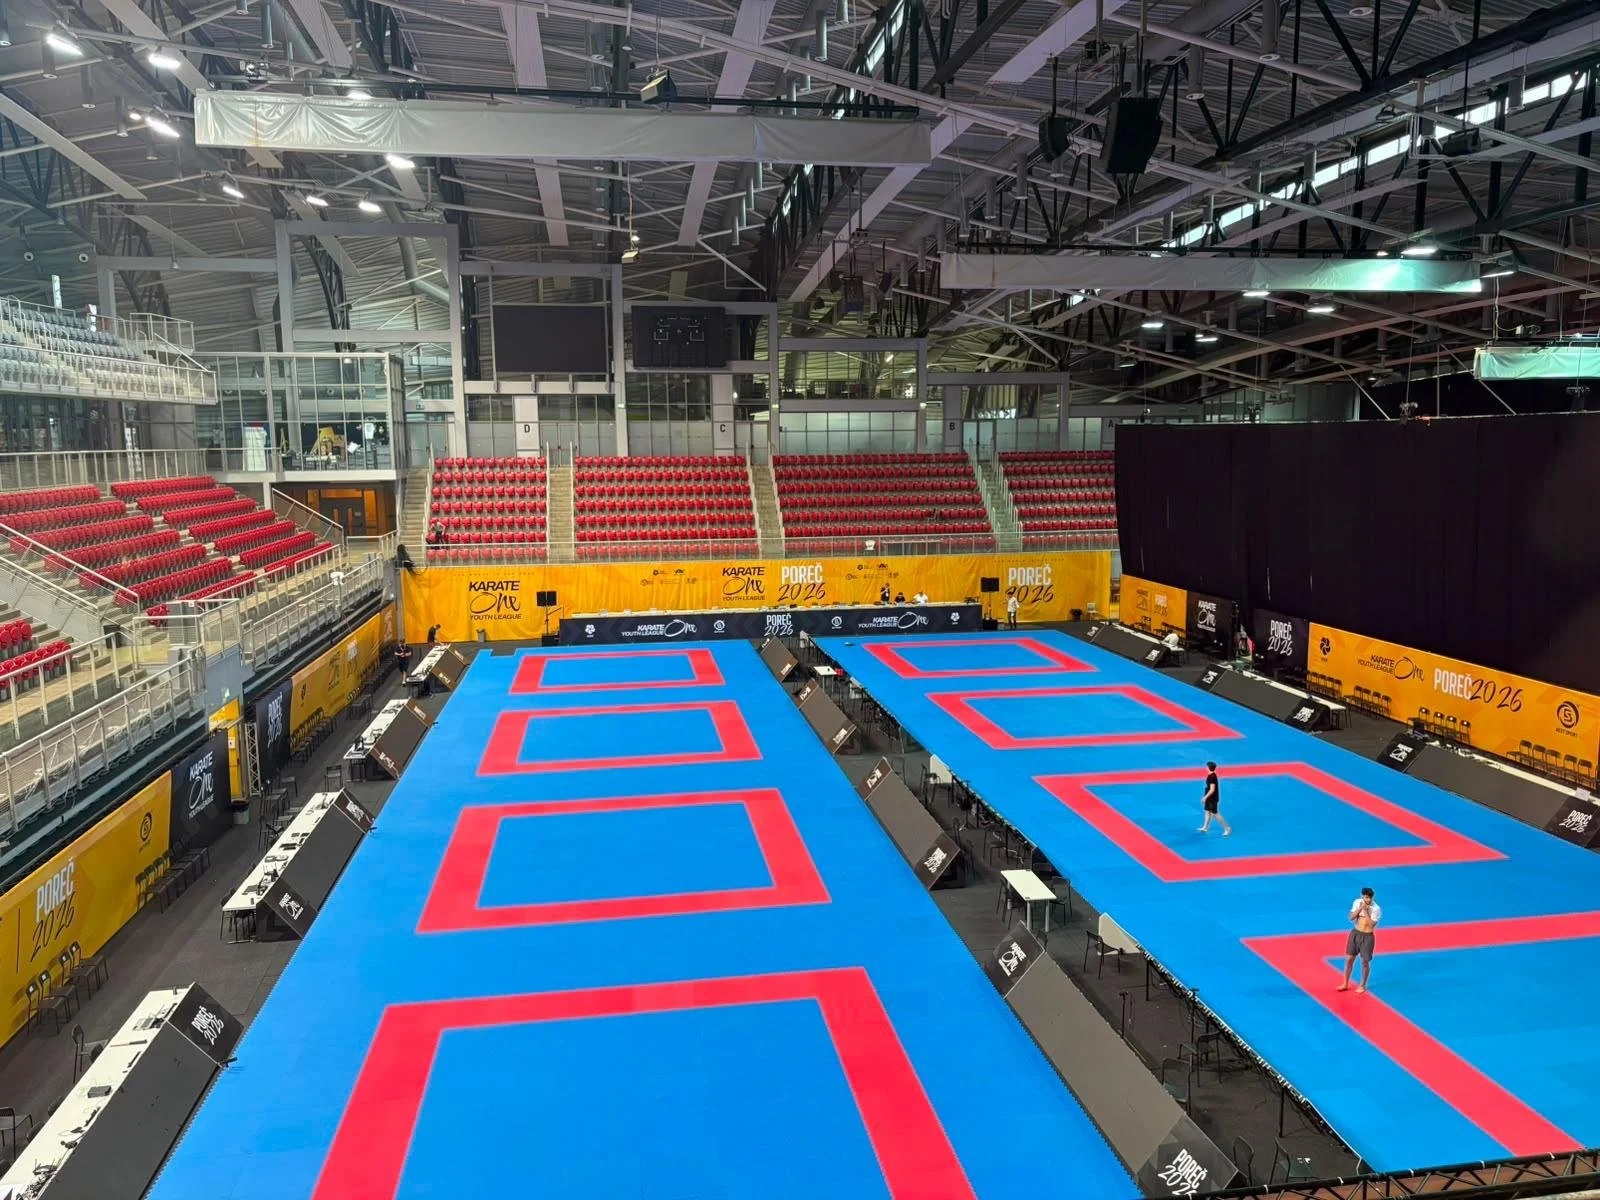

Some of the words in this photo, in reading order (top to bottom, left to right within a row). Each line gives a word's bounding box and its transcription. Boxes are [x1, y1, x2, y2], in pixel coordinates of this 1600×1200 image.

[524, 424, 531, 433] D
[720, 423, 727, 433] C
[722, 566, 766, 577] KARATE
[781, 561, 823, 585] POREČ
[1008, 563, 1052, 586] POREČ
[469, 580, 521, 592] KARATE
[766, 613, 792, 626] POREČ
[1270, 620, 1293, 641] POREČ
[1357, 659, 1374, 668] YOUTH
[1374, 665, 1394, 674] LEAGUE
[1370, 655, 1396, 668] KARATE
[1433, 668, 1473, 700] POREČ
[189, 750, 213, 781] KARATE
[36, 857, 75, 924] POREČ
[191, 1005, 213, 1034] POREČ
[1172, 1148, 1208, 1190] POREČ
